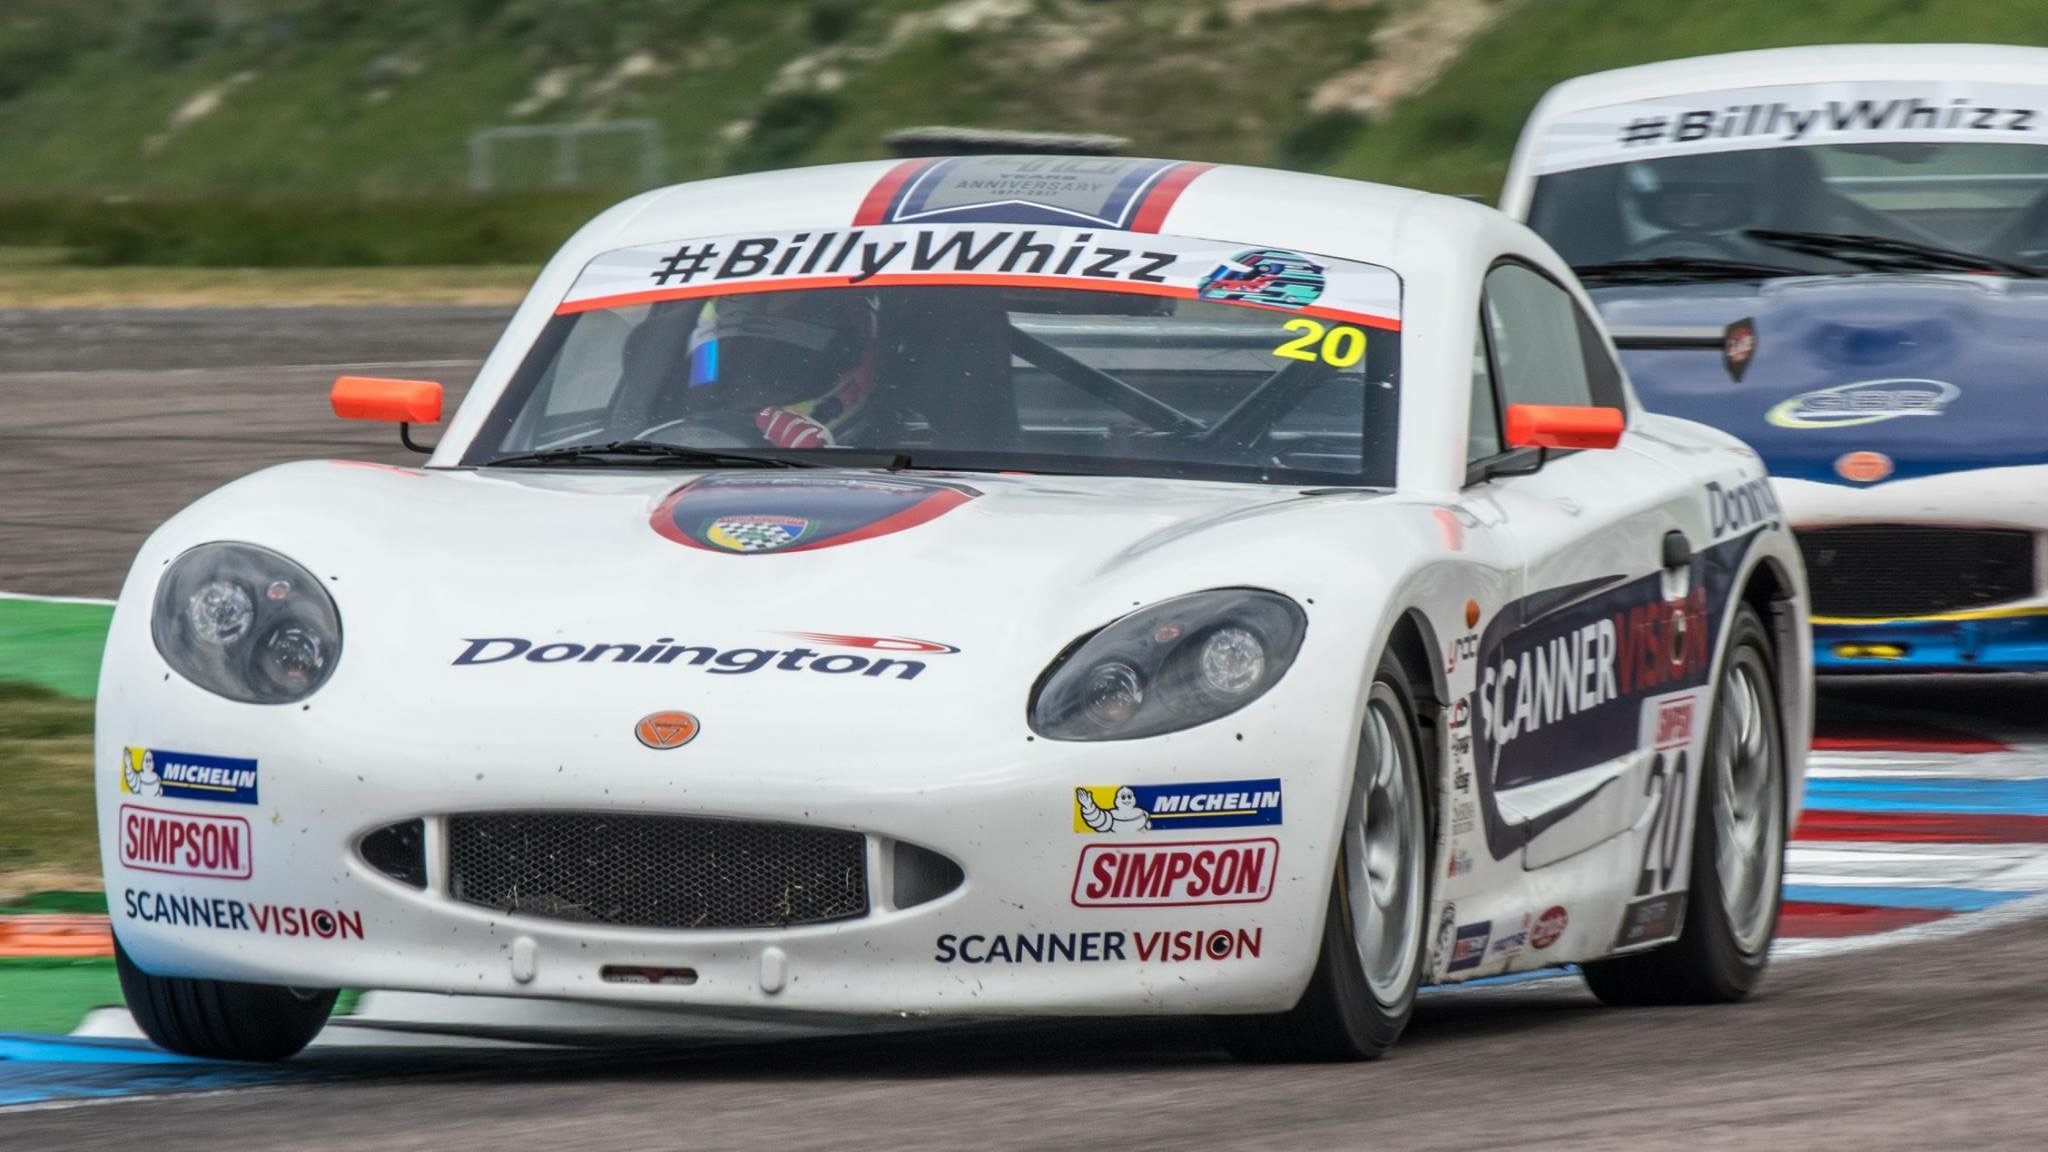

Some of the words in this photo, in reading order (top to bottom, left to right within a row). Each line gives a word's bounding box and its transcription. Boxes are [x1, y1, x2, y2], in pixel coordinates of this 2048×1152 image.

[1620, 99, 2034, 146] #BillyWhizz
[955, 180, 1104, 193] ANNIVERSARY
[650, 231, 1178, 286] #BillyWhizz
[1272, 318, 1367, 368] 20
[452, 637, 926, 681] Donington
[162, 762, 256, 789] MICHELIN
[1153, 790, 1281, 813] MICHELIN
[126, 814, 240, 871] SIMPSON
[1086, 847, 1267, 899] SIMPSON
